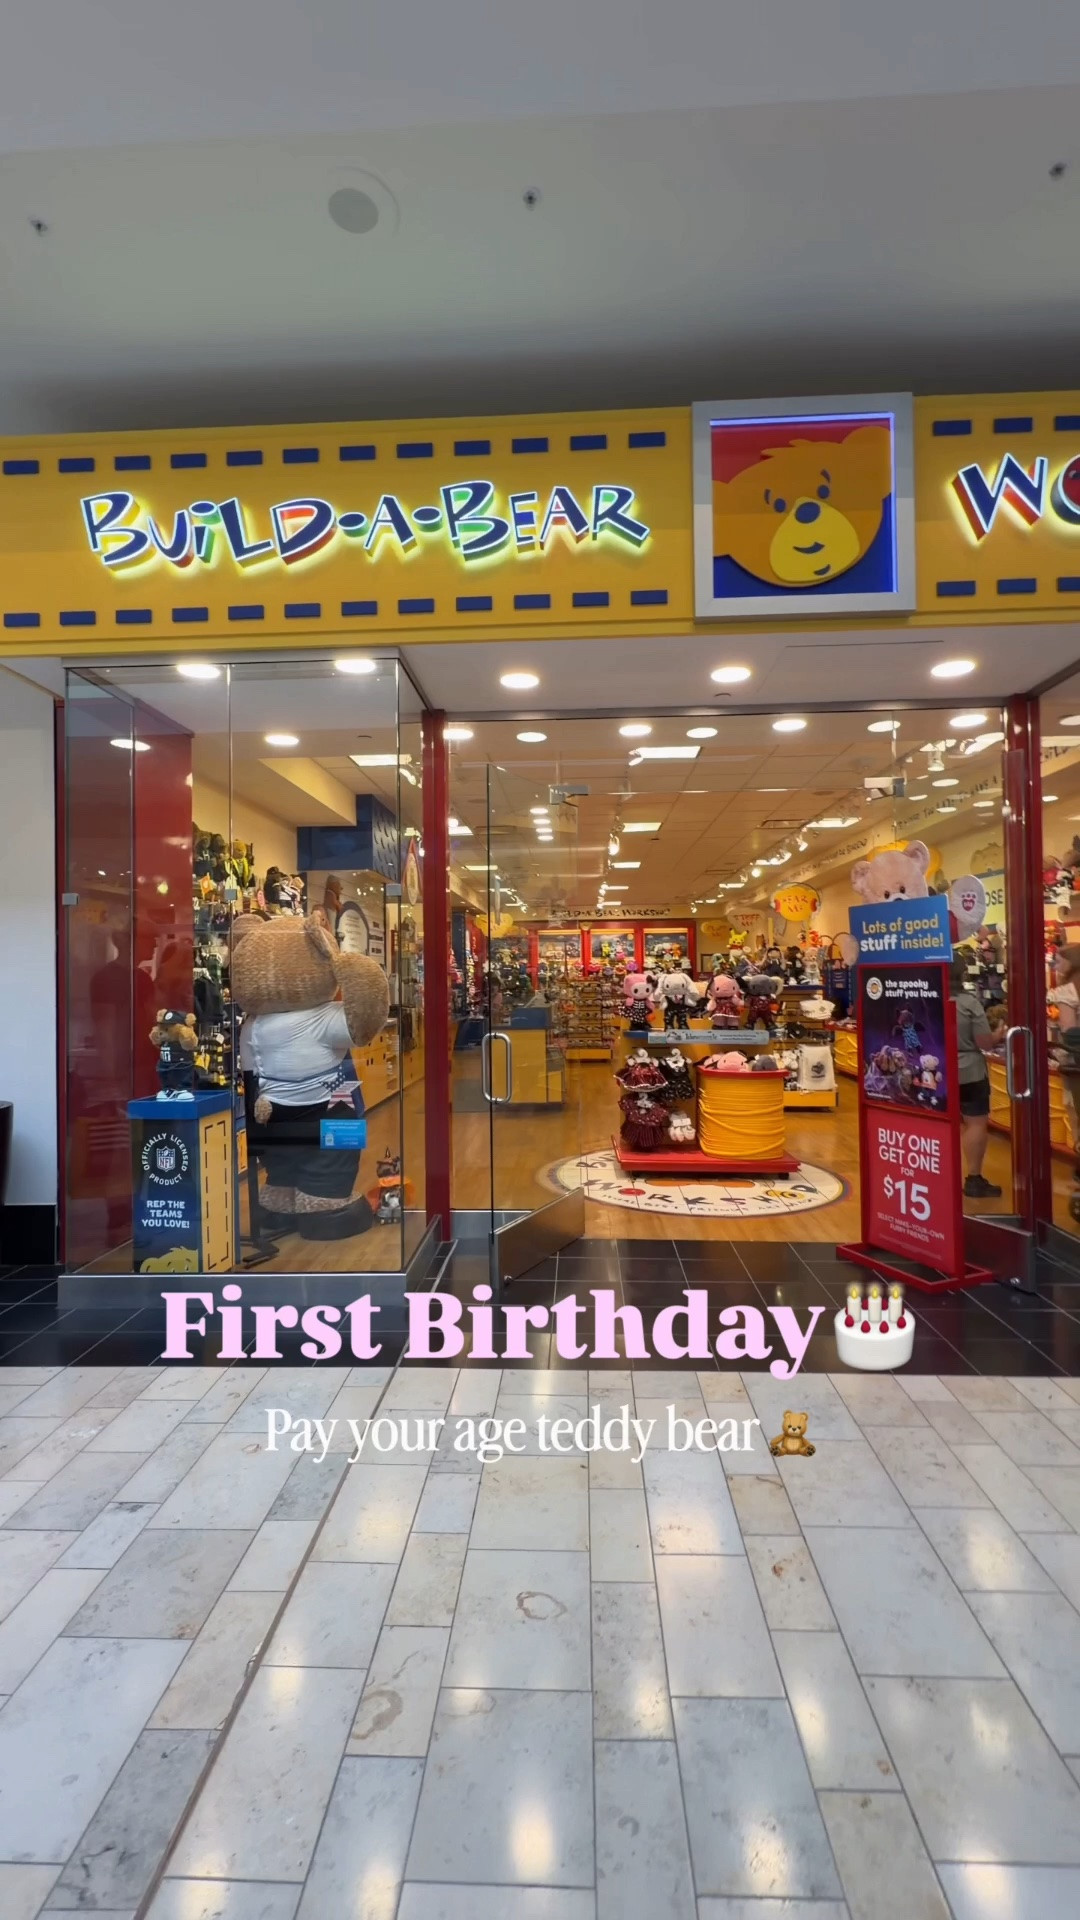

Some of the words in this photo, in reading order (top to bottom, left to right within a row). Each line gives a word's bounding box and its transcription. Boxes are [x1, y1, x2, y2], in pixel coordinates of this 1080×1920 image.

[862, 920, 887, 934] Lots
[889, 917, 903, 932] of
[905, 914, 939, 934] good
[860, 934, 898, 952] stuff
[900, 933, 944, 949] inside!
[885, 979, 898, 988] the
[898, 979, 929, 990] spooky
[885, 988, 903, 998] stuff
[904, 990, 919, 999] you
[878, 1127, 906, 1148] BUY
[908, 1134, 940, 1156] ONE
[141, 1132, 167, 1171] OFFICIALLY
[170, 1134, 189, 1172] LICENSED
[159, 1156, 174, 1169] NFL
[878, 1145, 905, 1165] GET
[907, 1152, 940, 1174] ONE
[901, 1167, 914, 1178] FOR
[149, 1173, 182, 1186] PRODUCT
[883, 1174, 931, 1221] $15
[146, 1200, 166, 1208] REP
[168, 1200, 185, 1209] THE
[150, 1209, 183, 1219] TEAMS
[877, 1211, 895, 1223] SELECT
[142, 1219, 162, 1227] YOU
[163, 1219, 190, 1229] LOVE!
